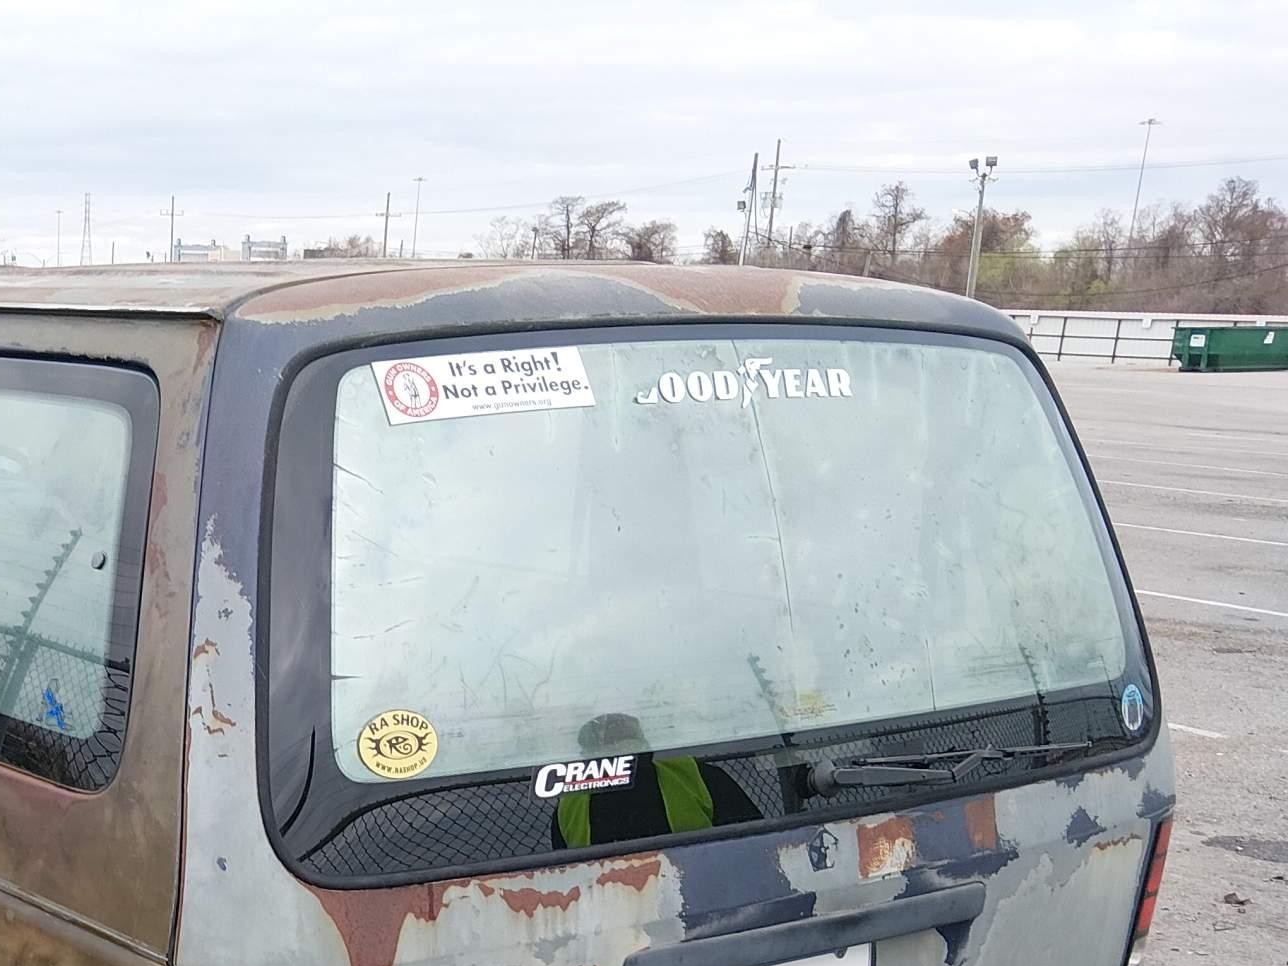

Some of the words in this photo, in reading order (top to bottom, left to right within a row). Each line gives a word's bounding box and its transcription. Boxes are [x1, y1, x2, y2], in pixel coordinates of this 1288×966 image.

[385, 368, 397, 386] GUN
[396, 363, 431, 382] OWNERS
[448, 360, 477, 377] It's
[483, 362, 496, 375] a
[500, 351, 562, 378] Right!
[442, 383, 478, 400] Not
[485, 384, 497, 396] a
[502, 377, 589, 396] Privilege.
[393, 399, 407, 412] OF
[406, 396, 437, 417] AMERICA
[472, 398, 552, 411] www.gunowners.org
[368, 716, 389, 735] RA
[392, 713, 429, 731] SHOP
[535, 755, 634, 798] CRANE
[563, 776, 630, 793] ELECTRONICS
